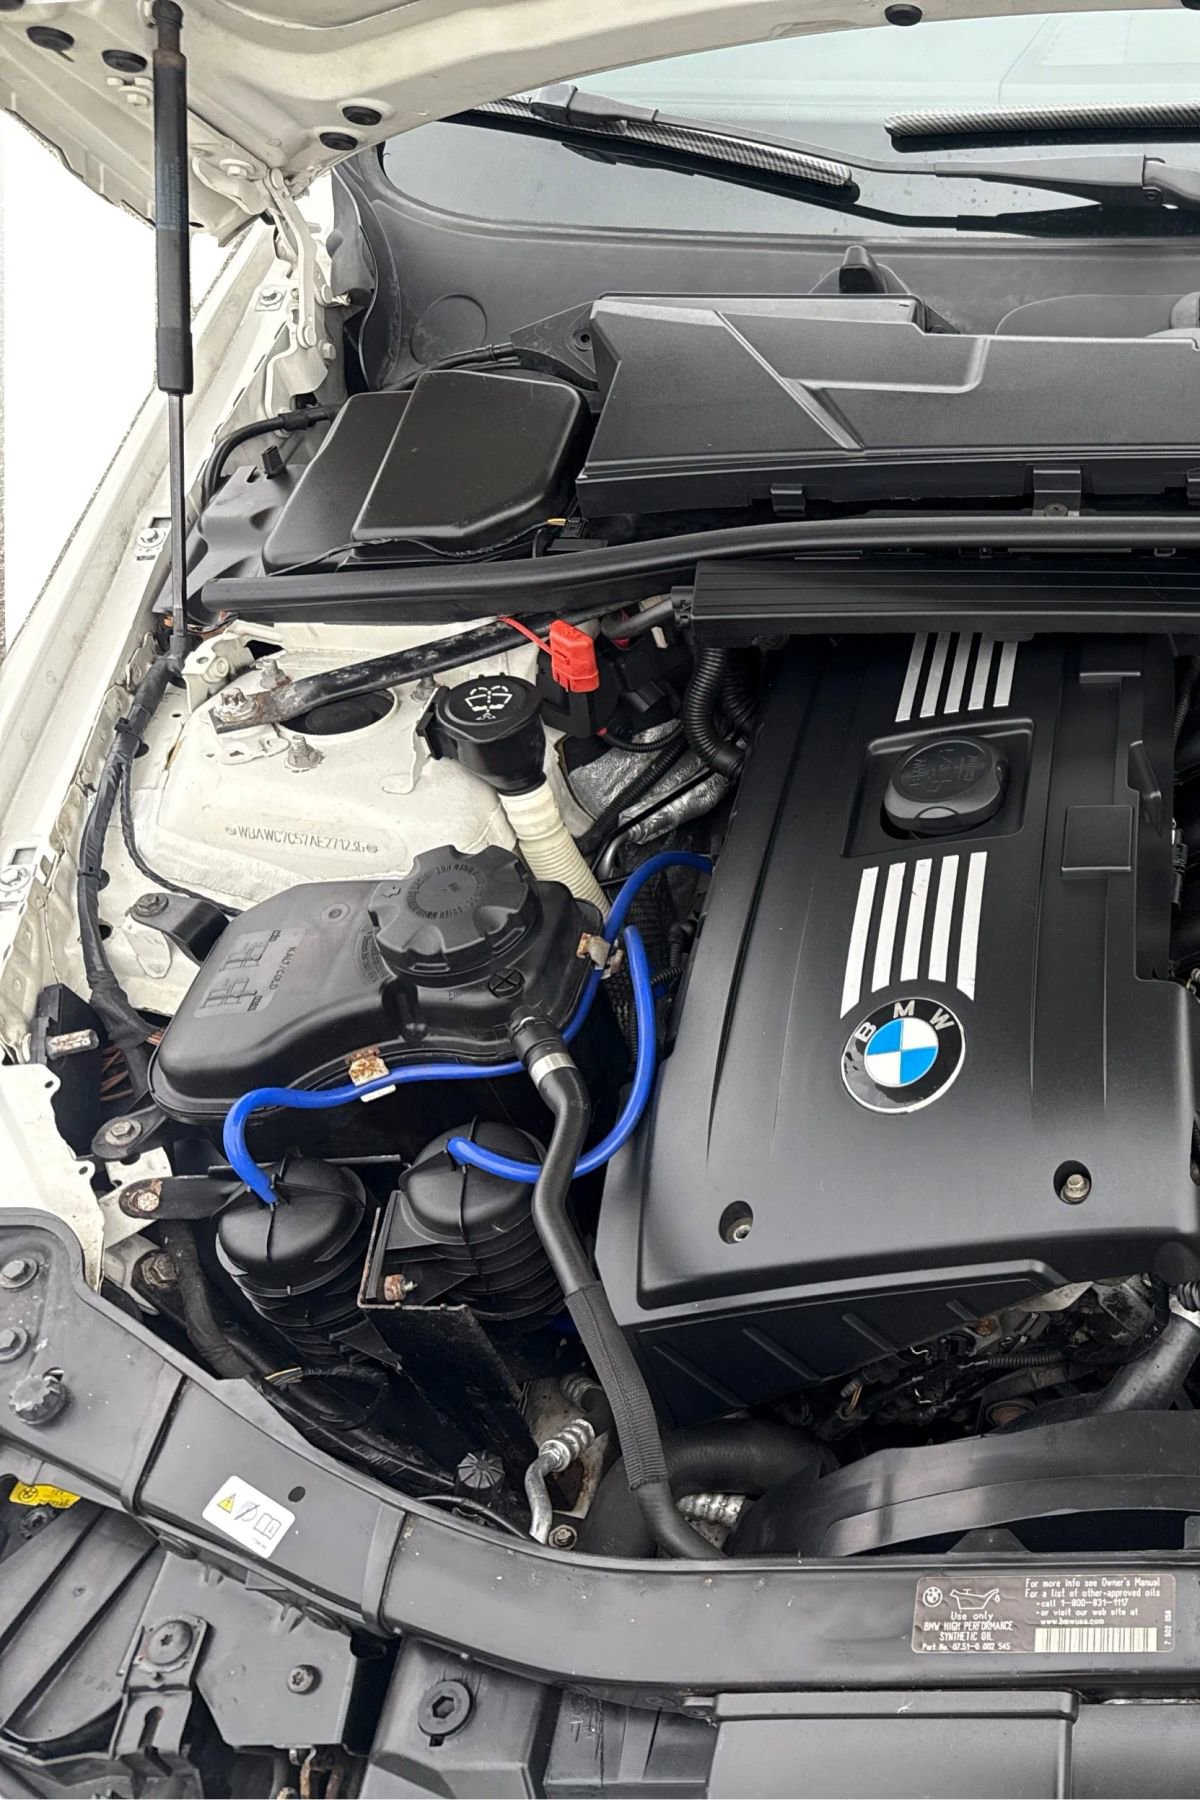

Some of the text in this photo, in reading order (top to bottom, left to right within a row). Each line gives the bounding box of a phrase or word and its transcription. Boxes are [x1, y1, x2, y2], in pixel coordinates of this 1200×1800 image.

[854, 1000, 955, 1043] BMW
[1025, 1578, 1039, 1588] For
[1101, 1577, 1130, 1587] Owner's
[1134, 1576, 1160, 1587] Manual
[1025, 1588, 1038, 1598] For
[1051, 1588, 1065, 1597] list
[1069, 1588, 1078, 1597] of
[1144, 1587, 1160, 1597] oils
[1061, 1597, 1128, 1607] 1-800-831-1117
[950, 1610, 994, 1623] Use only
[1053, 1608, 1071, 1616] visit
[1092, 1608, 1107, 1616] web
[1111, 1608, 1126, 1616] site
[1130, 1608, 1138, 1616] at
[923, 1620, 1014, 1632] BMW HIGH PERFORMANCE
[939, 1631, 994, 1641] SYNTHETIC OIL
[922, 1642, 936, 1651] Part
